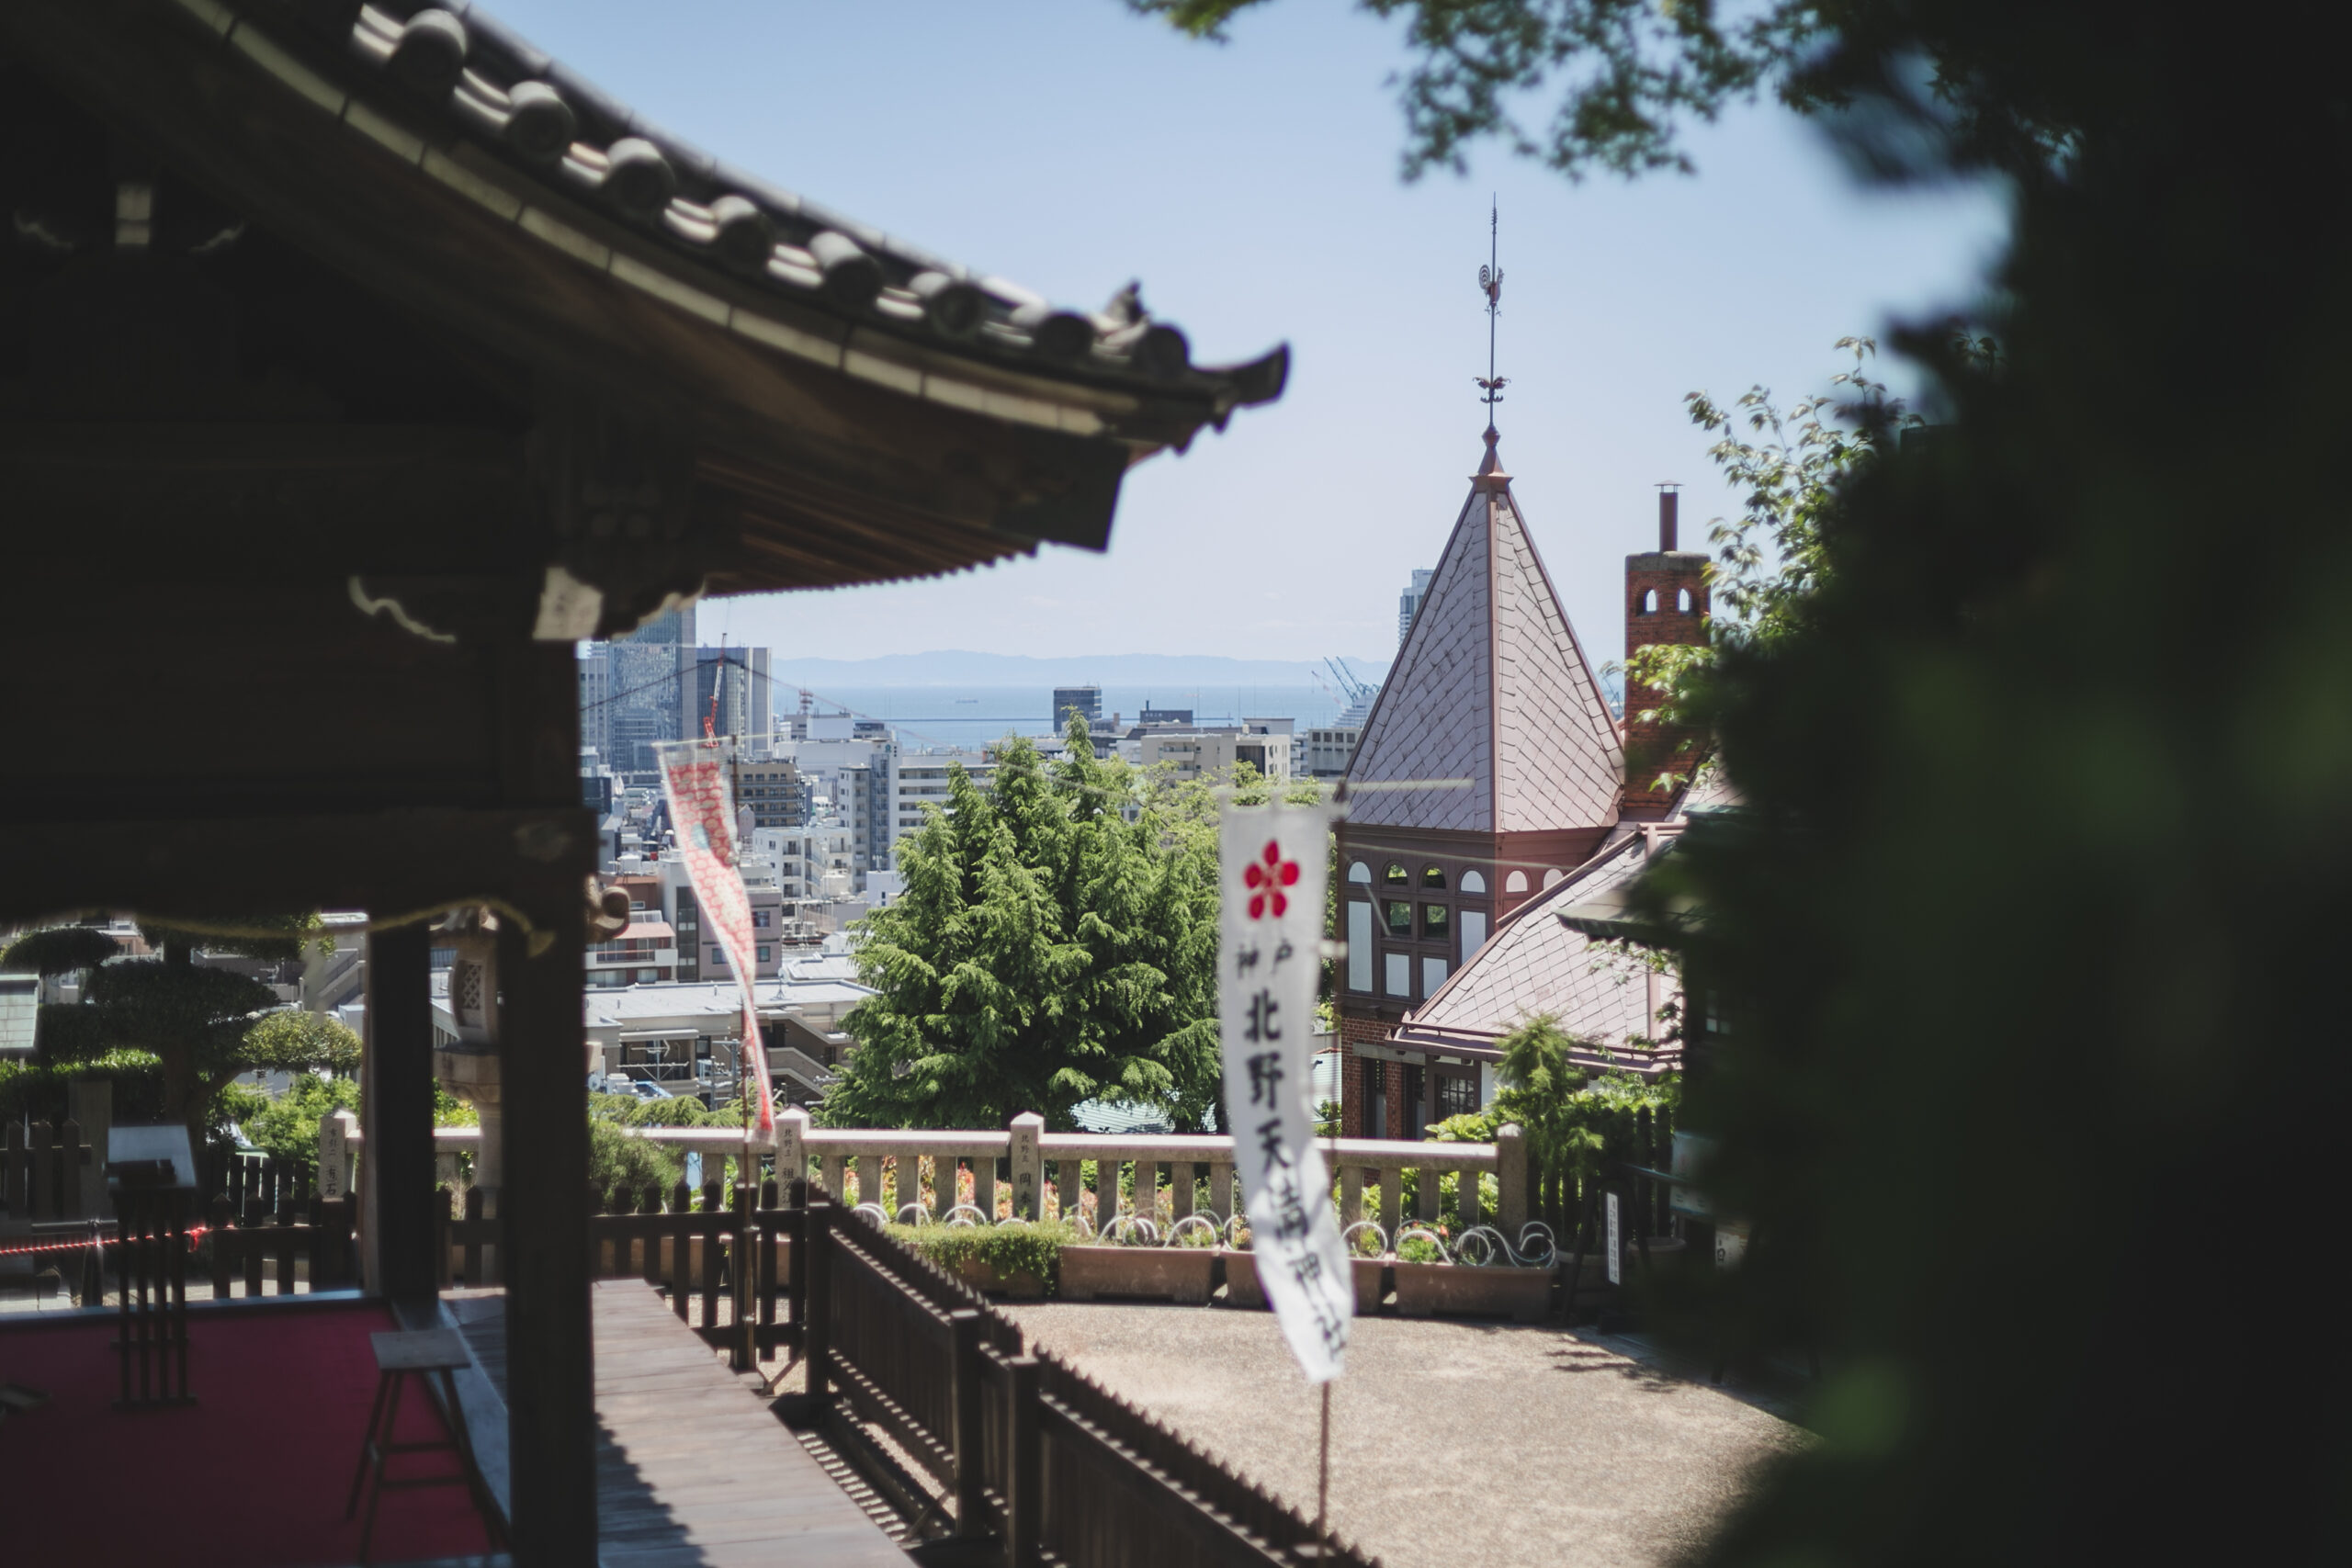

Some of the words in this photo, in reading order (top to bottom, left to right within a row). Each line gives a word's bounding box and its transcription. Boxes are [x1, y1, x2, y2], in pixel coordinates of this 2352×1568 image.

[1236, 938, 1294, 980] 神戸
[1244, 987, 1346, 1362] 北野天満神社
